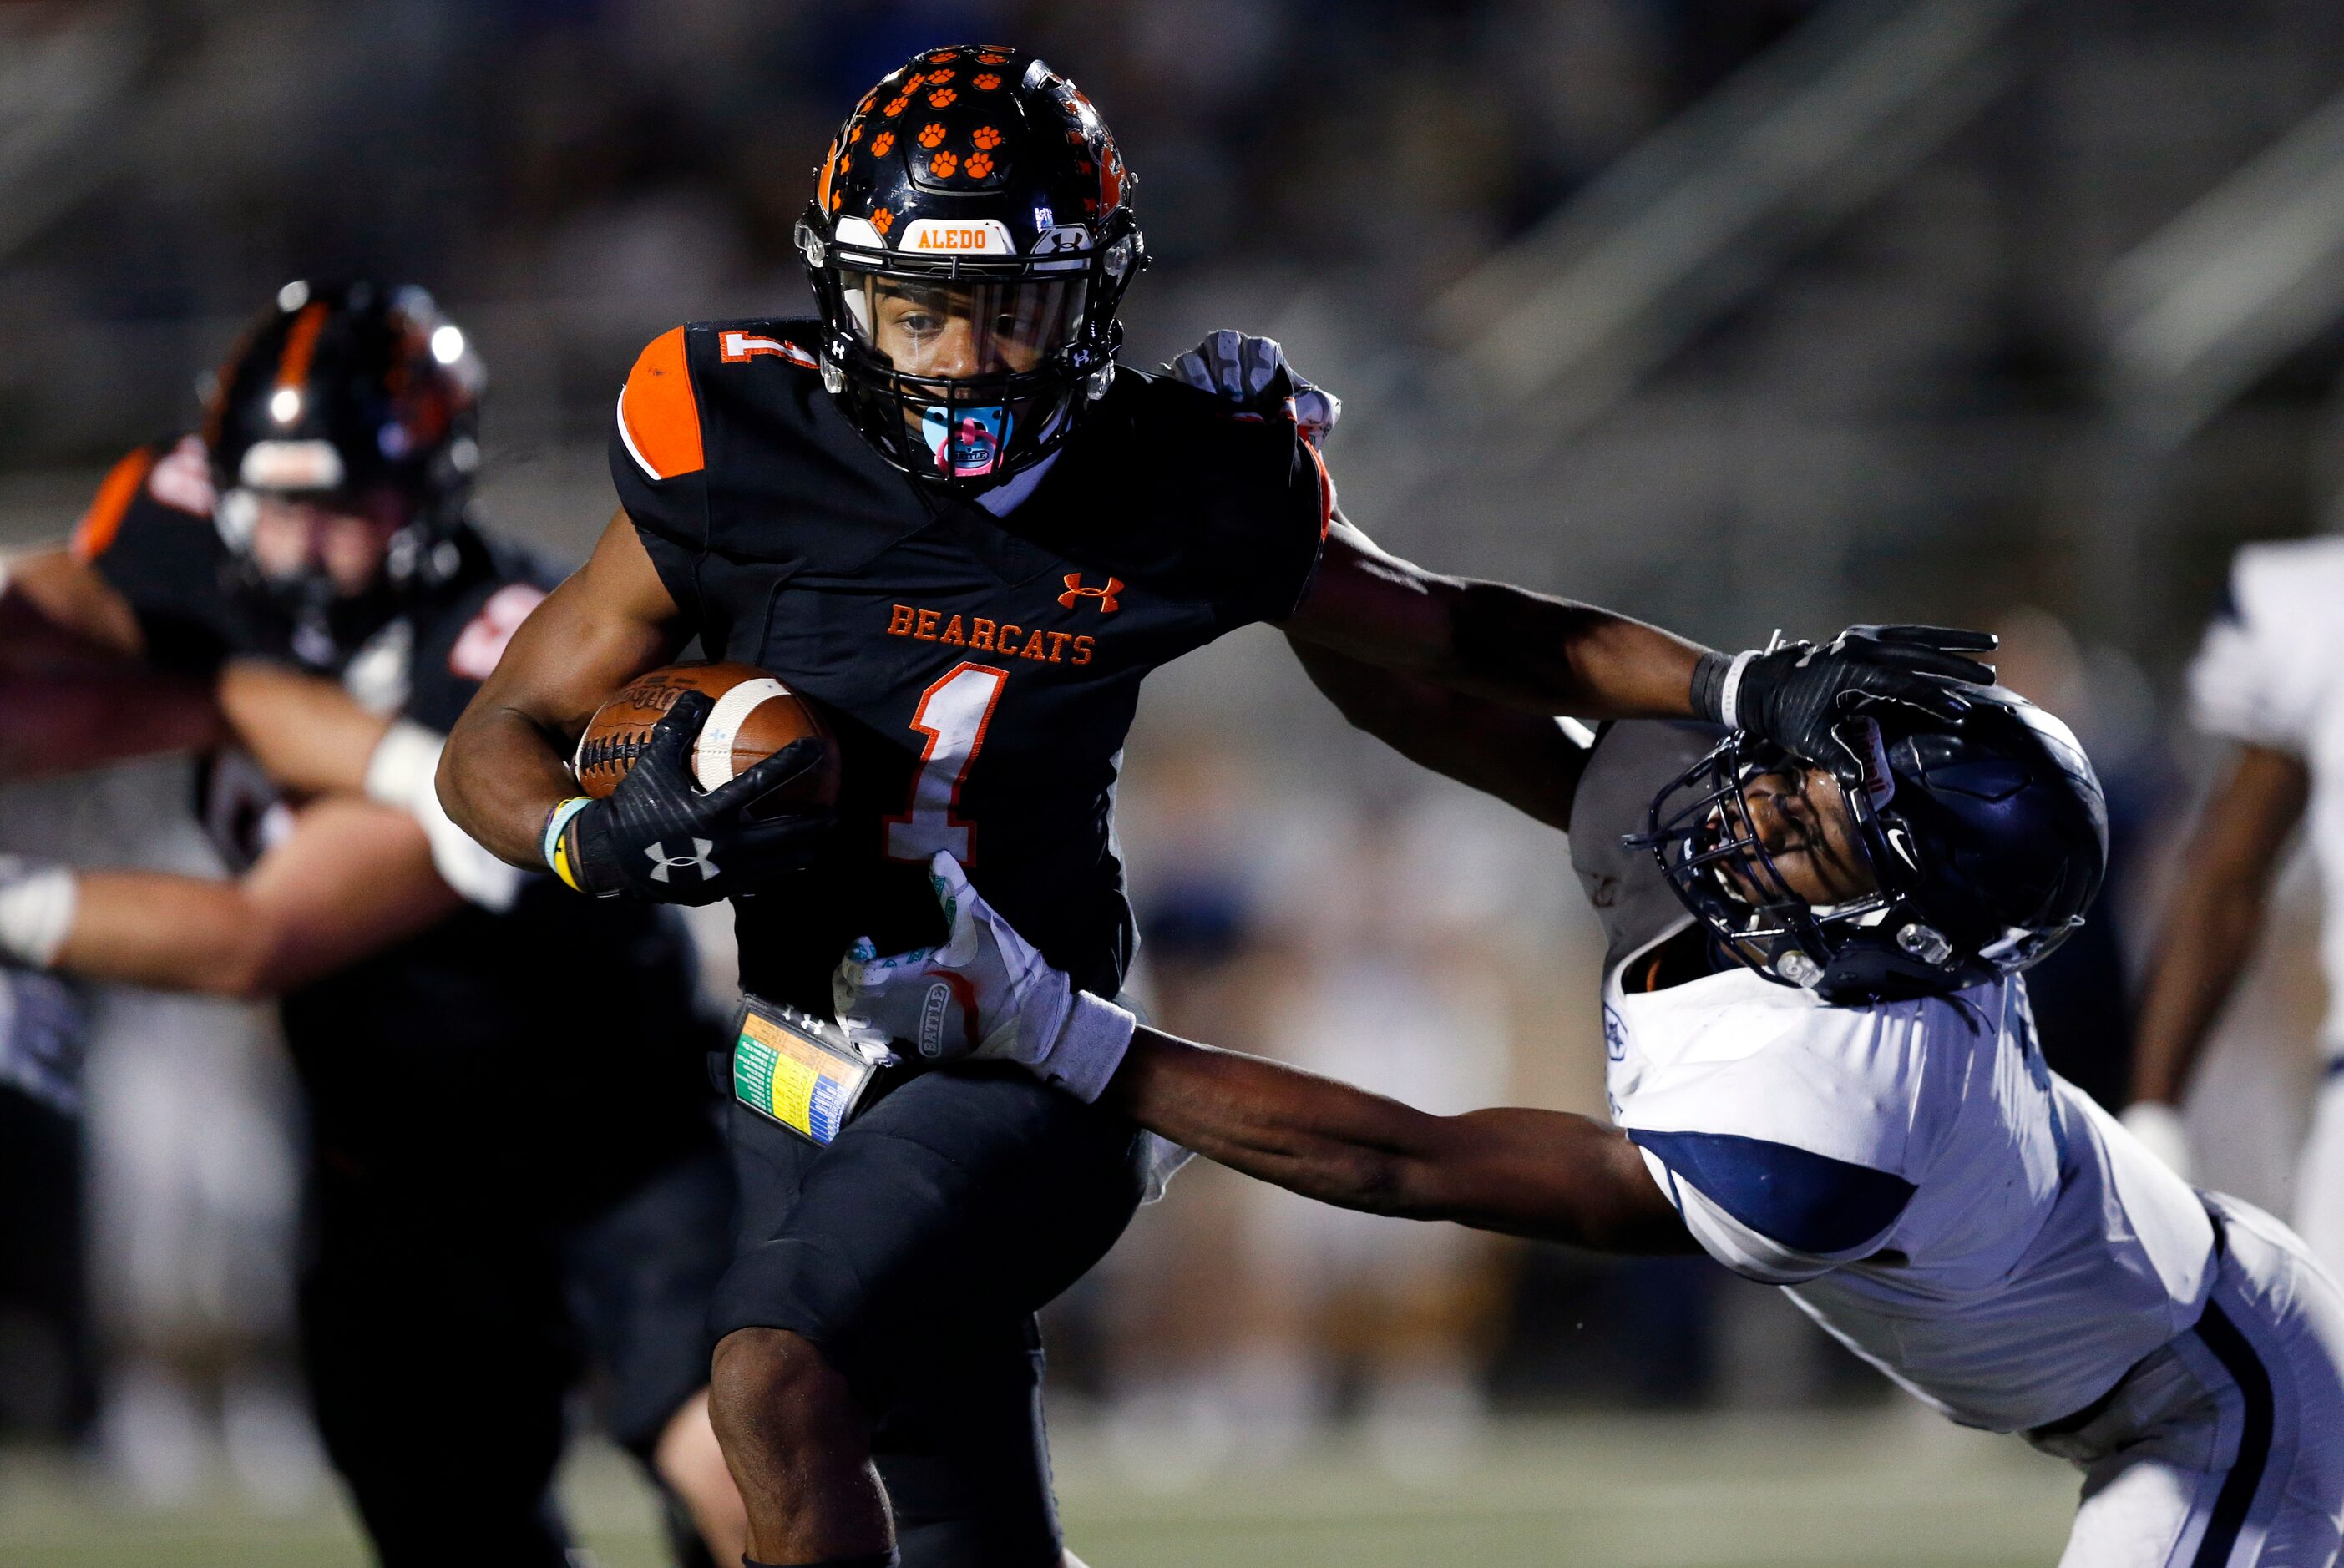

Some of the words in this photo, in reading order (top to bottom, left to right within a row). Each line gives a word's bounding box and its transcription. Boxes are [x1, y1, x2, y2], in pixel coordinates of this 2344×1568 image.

[918, 229, 986, 250] ALEDO
[887, 604, 1095, 665] BEARCATS
[882, 660, 1010, 867] 1
[924, 989, 946, 1051] BATTLE
